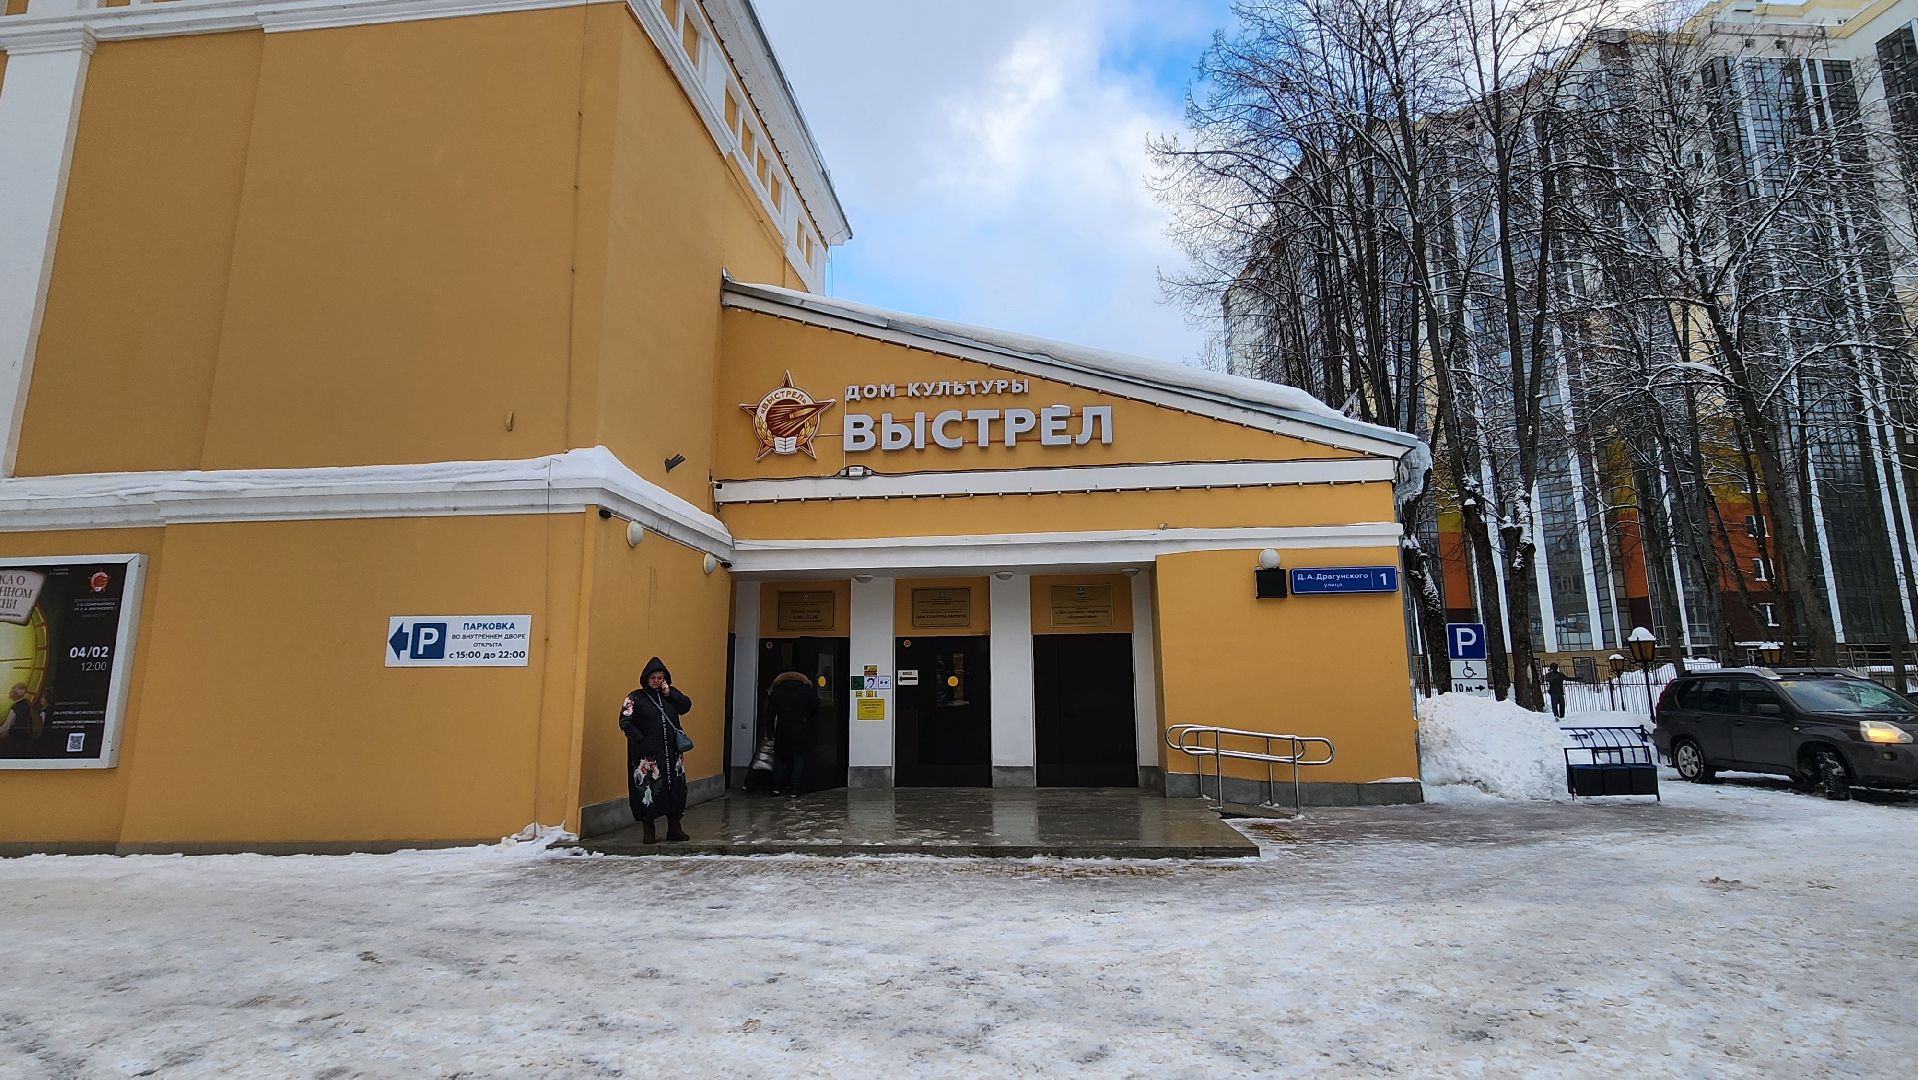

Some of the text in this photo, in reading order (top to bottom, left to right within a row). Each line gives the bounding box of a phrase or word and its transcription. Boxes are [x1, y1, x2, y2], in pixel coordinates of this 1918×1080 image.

[845, 379, 1030, 401] ДОМ КУЛЬТУРЫ
[843, 405, 1113, 451] ВЫСТРЕЛ
[1379, 573, 1388, 586] 1
[463, 622, 515, 630] ПАРКОВКА
[69, 646, 109, 659] 04/02
[455, 651, 481, 659] 15:00
[483, 652, 496, 660] до
[498, 650, 526, 659] 22:00
[80, 661, 107, 671] 12:00
[1454, 683, 1464, 693] 10
